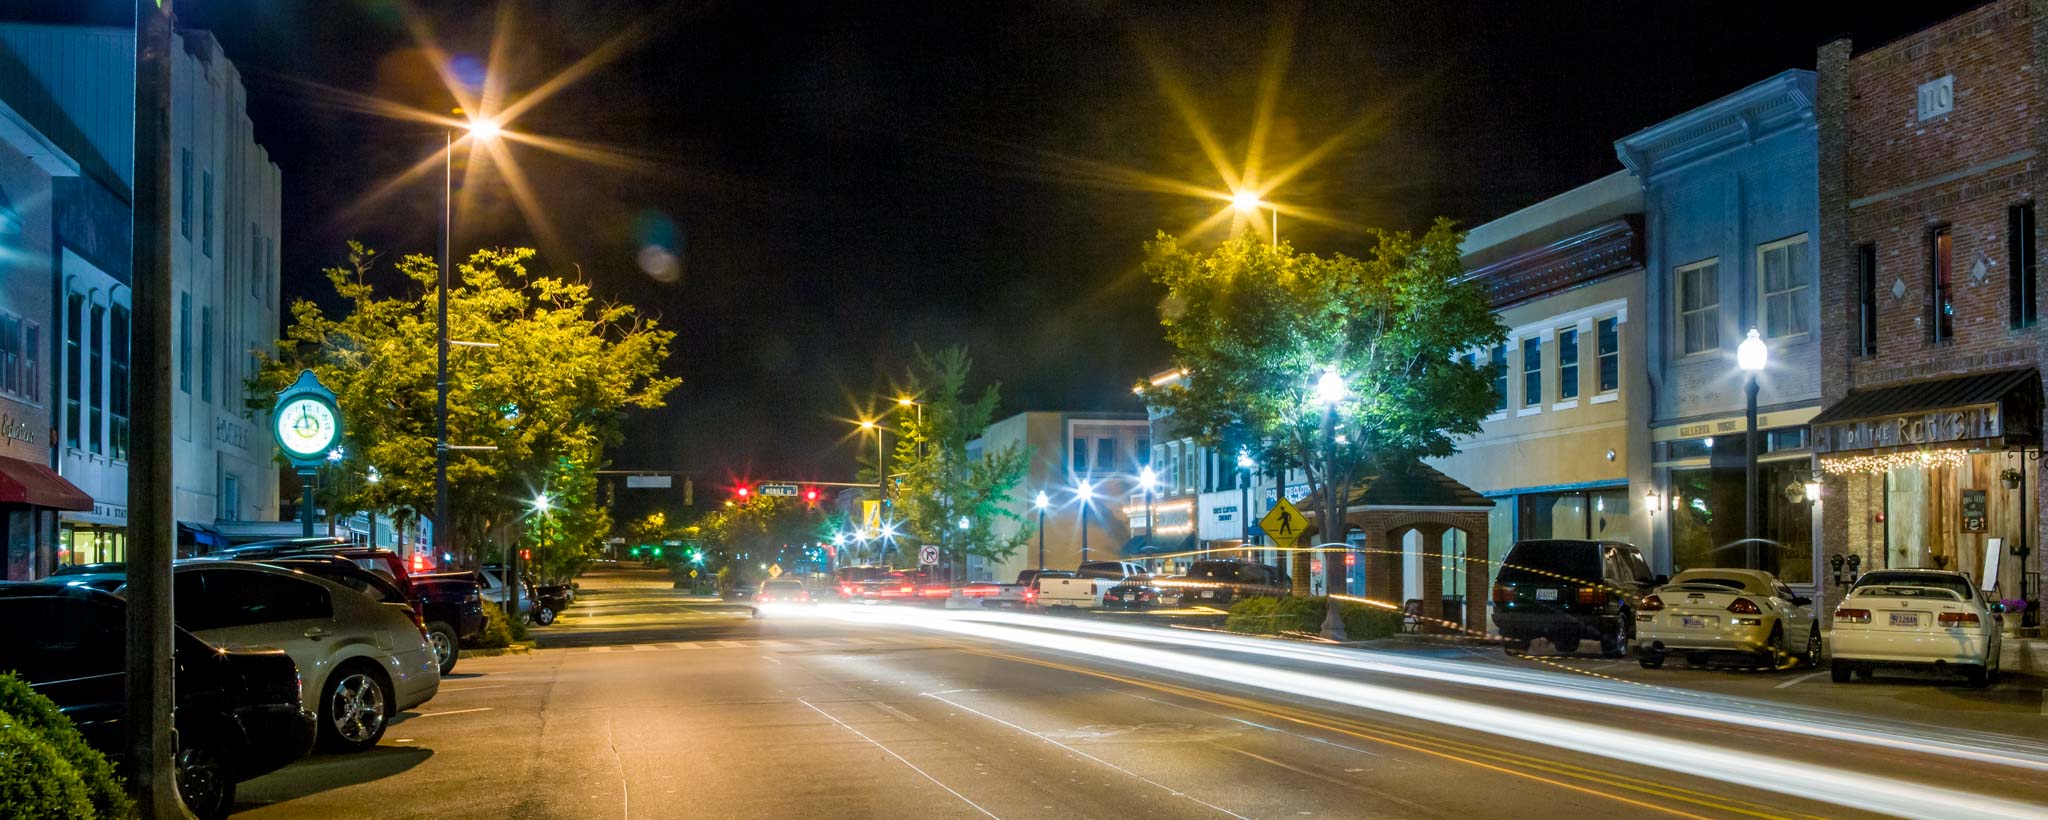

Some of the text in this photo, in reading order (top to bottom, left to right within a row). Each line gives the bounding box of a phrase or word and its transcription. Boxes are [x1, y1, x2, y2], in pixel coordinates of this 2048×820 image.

[1848, 411, 1967, 444] ON THE ROCKS
[765, 487, 785, 496] MOBILE
